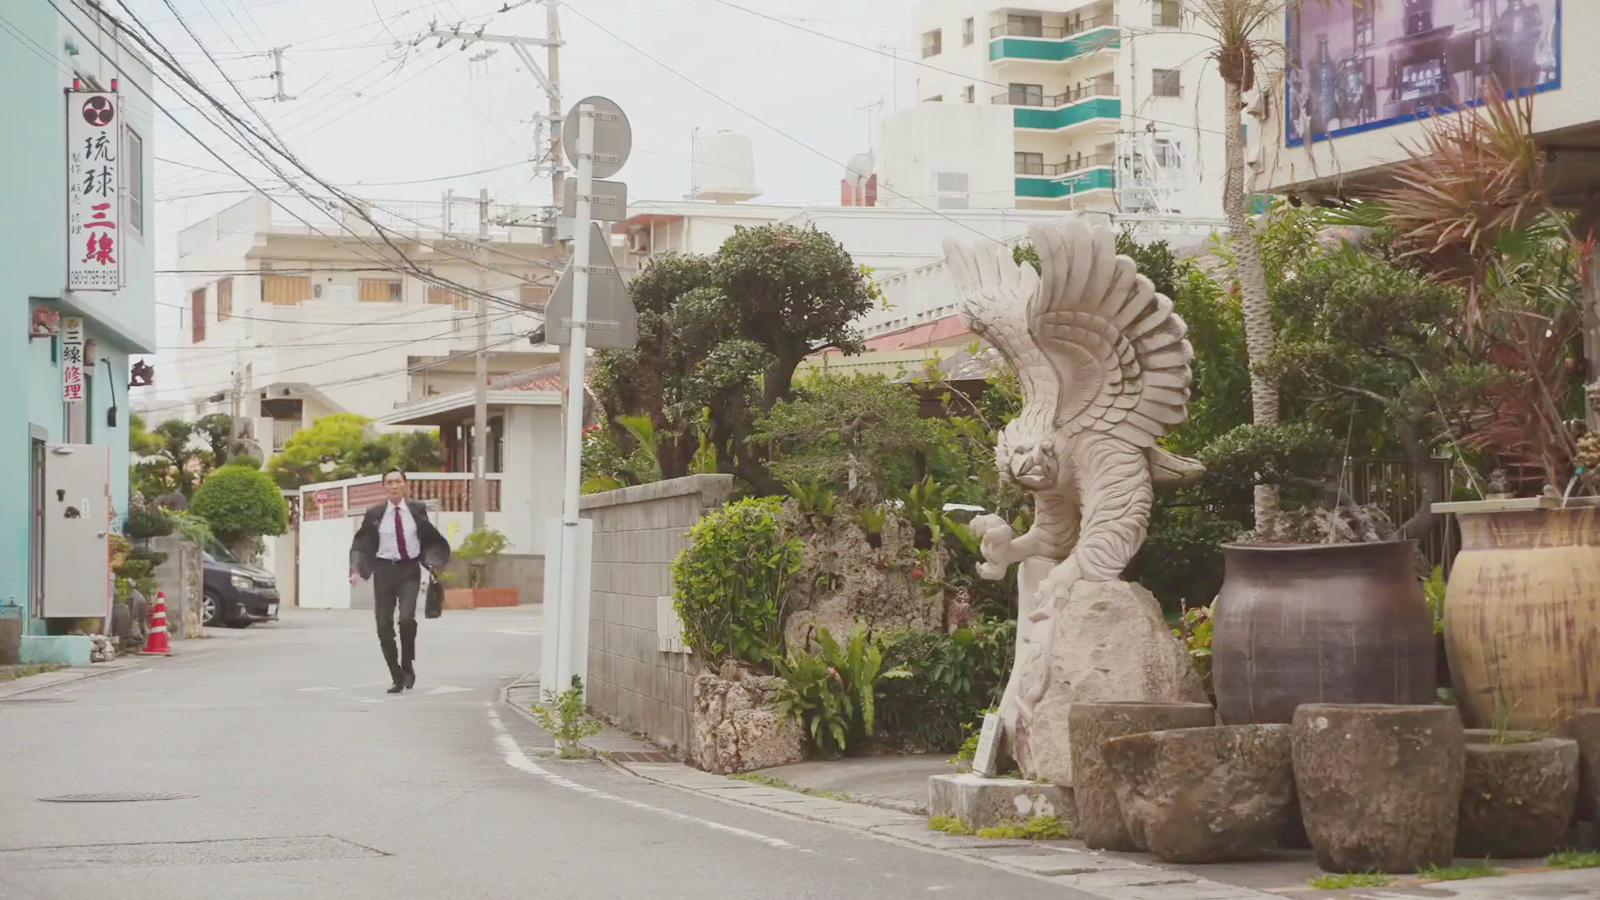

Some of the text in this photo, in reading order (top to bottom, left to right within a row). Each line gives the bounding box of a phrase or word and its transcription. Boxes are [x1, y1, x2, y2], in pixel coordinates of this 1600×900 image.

[83, 130, 116, 266] 琉球三線
[63, 330, 83, 400] 三線修理
